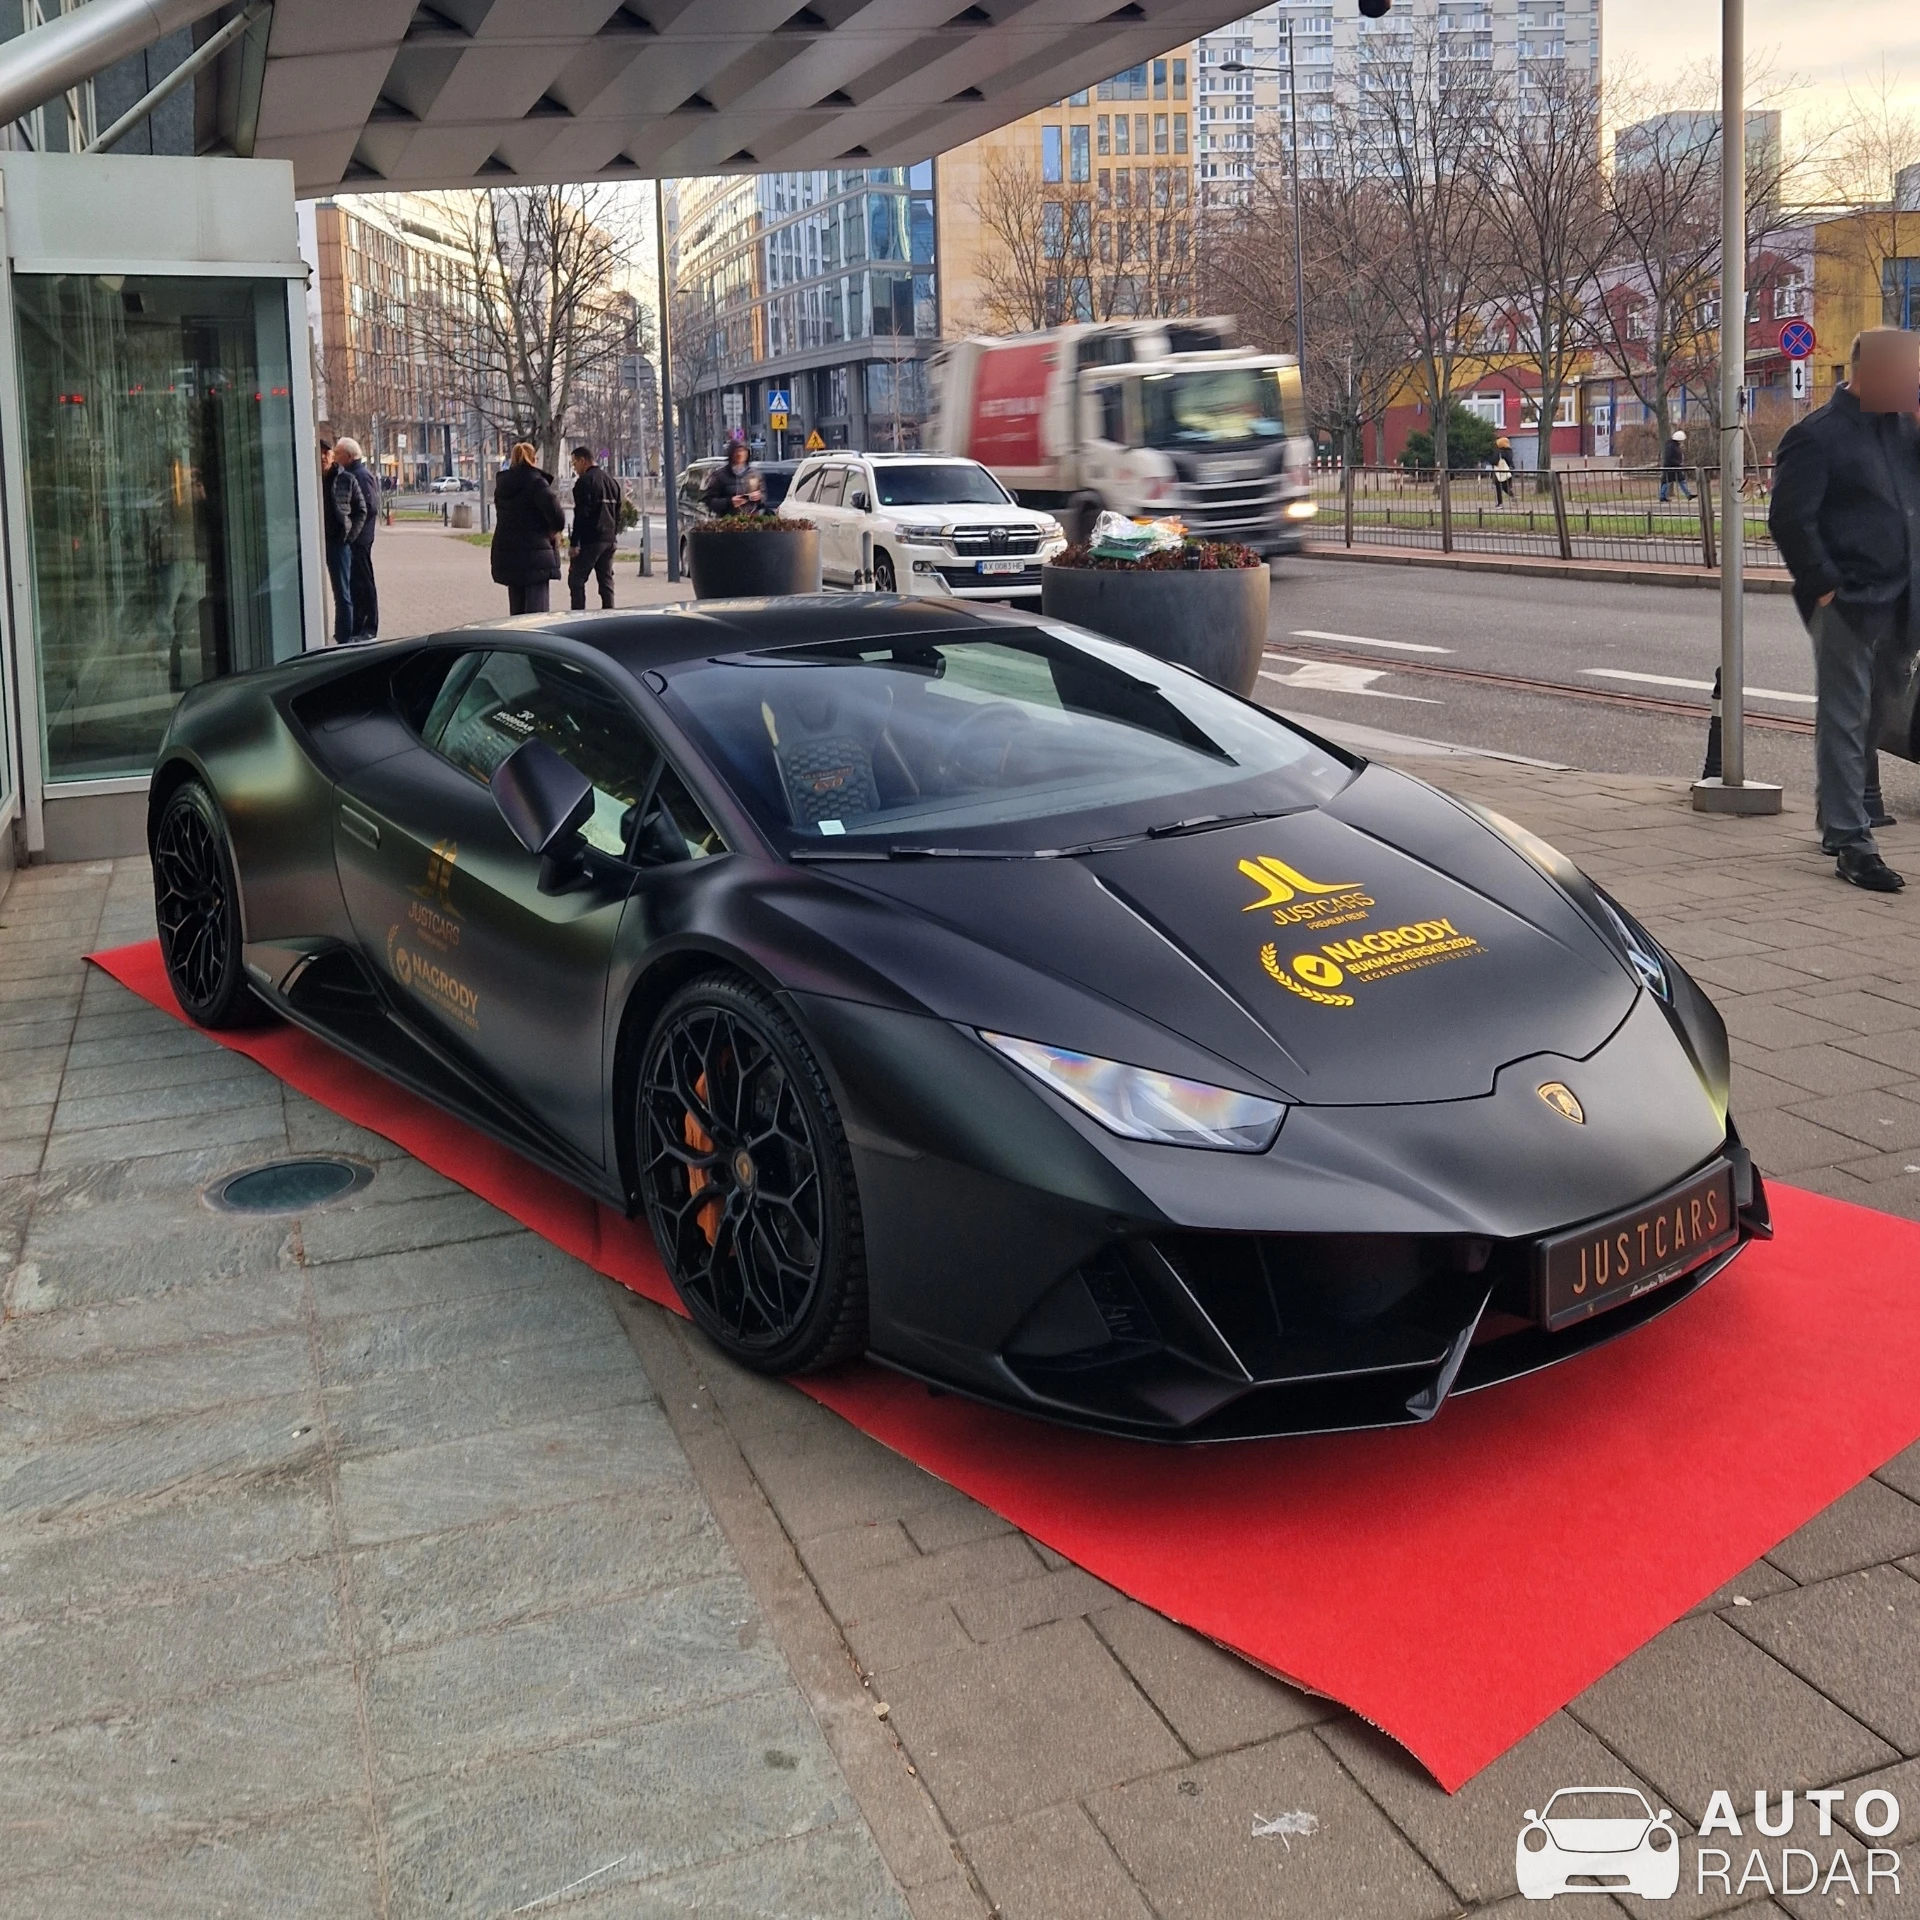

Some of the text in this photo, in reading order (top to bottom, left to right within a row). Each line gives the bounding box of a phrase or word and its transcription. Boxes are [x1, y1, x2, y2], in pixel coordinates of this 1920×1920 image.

[408, 901, 460, 946] JUSTCARS
[1272, 892, 1376, 925] JUSTCARS
[1345, 910, 1369, 922] RENT
[1321, 918, 1459, 963] NAGRODY
[413, 952, 479, 1015] NAGRODY
[1572, 1189, 1718, 1294] JUSTCARS
